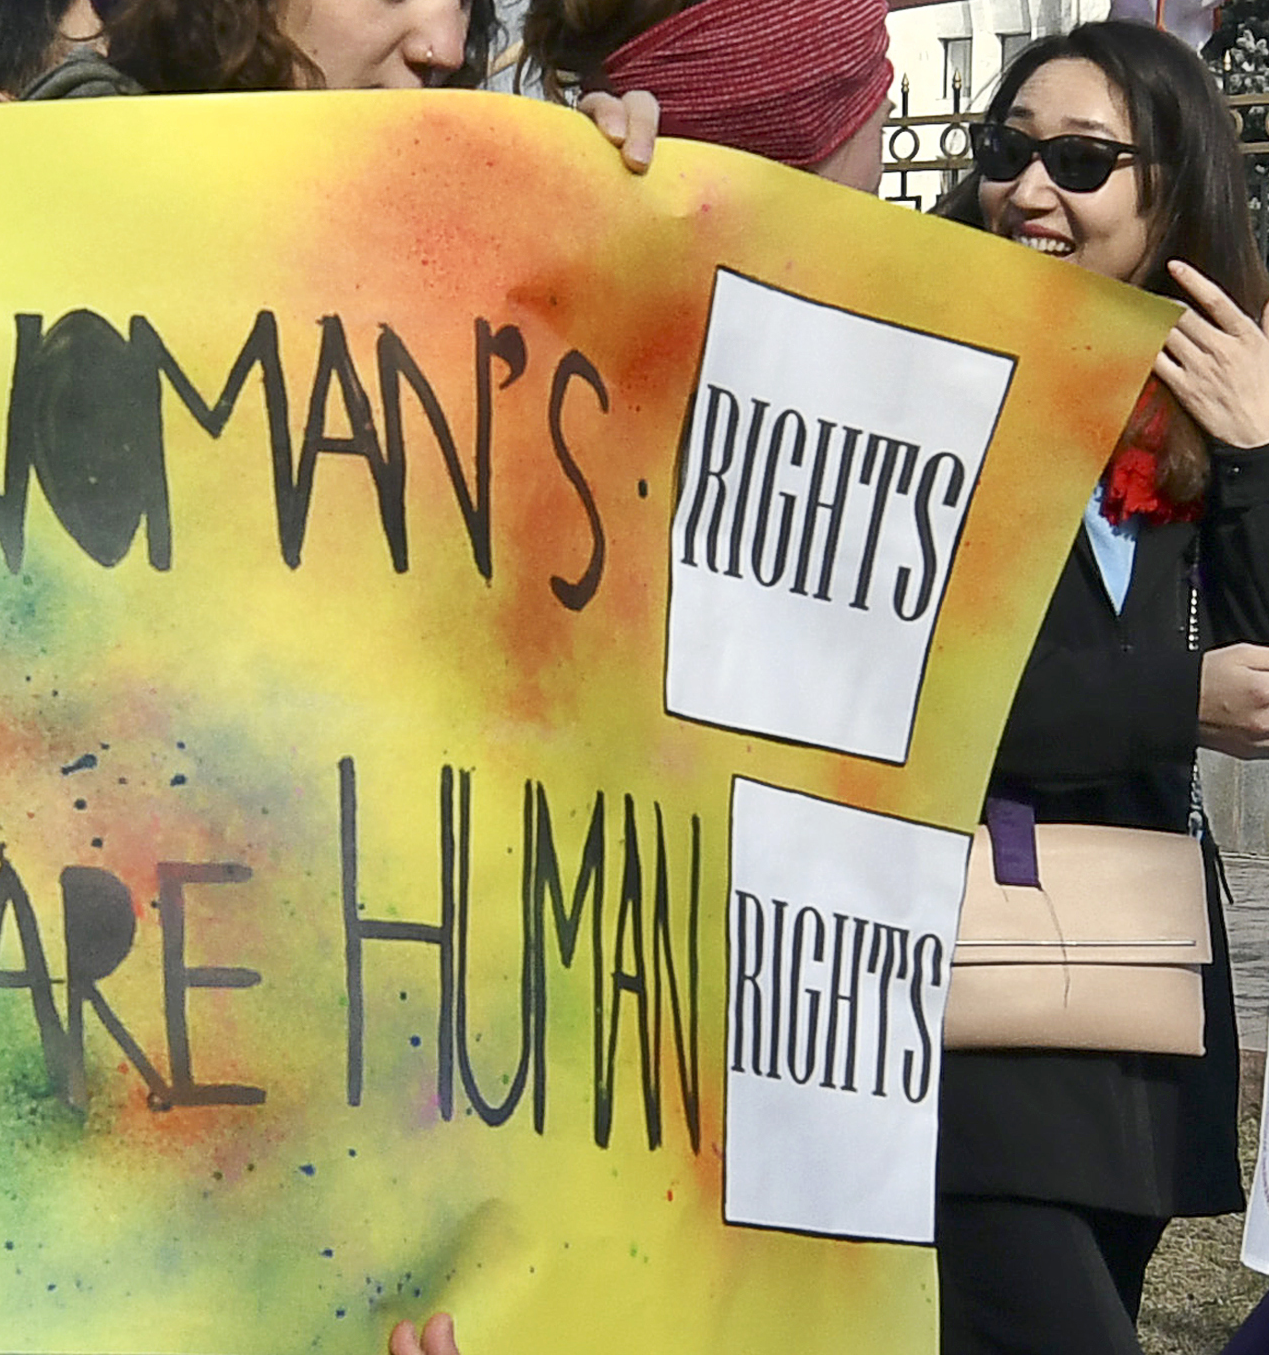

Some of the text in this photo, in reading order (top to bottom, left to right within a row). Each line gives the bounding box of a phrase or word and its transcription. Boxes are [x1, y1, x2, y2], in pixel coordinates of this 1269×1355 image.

[680, 383, 968, 624] RIGHTS
[338, 755, 701, 1156] HUMAN
[731, 889, 946, 1104] RIGHTS
